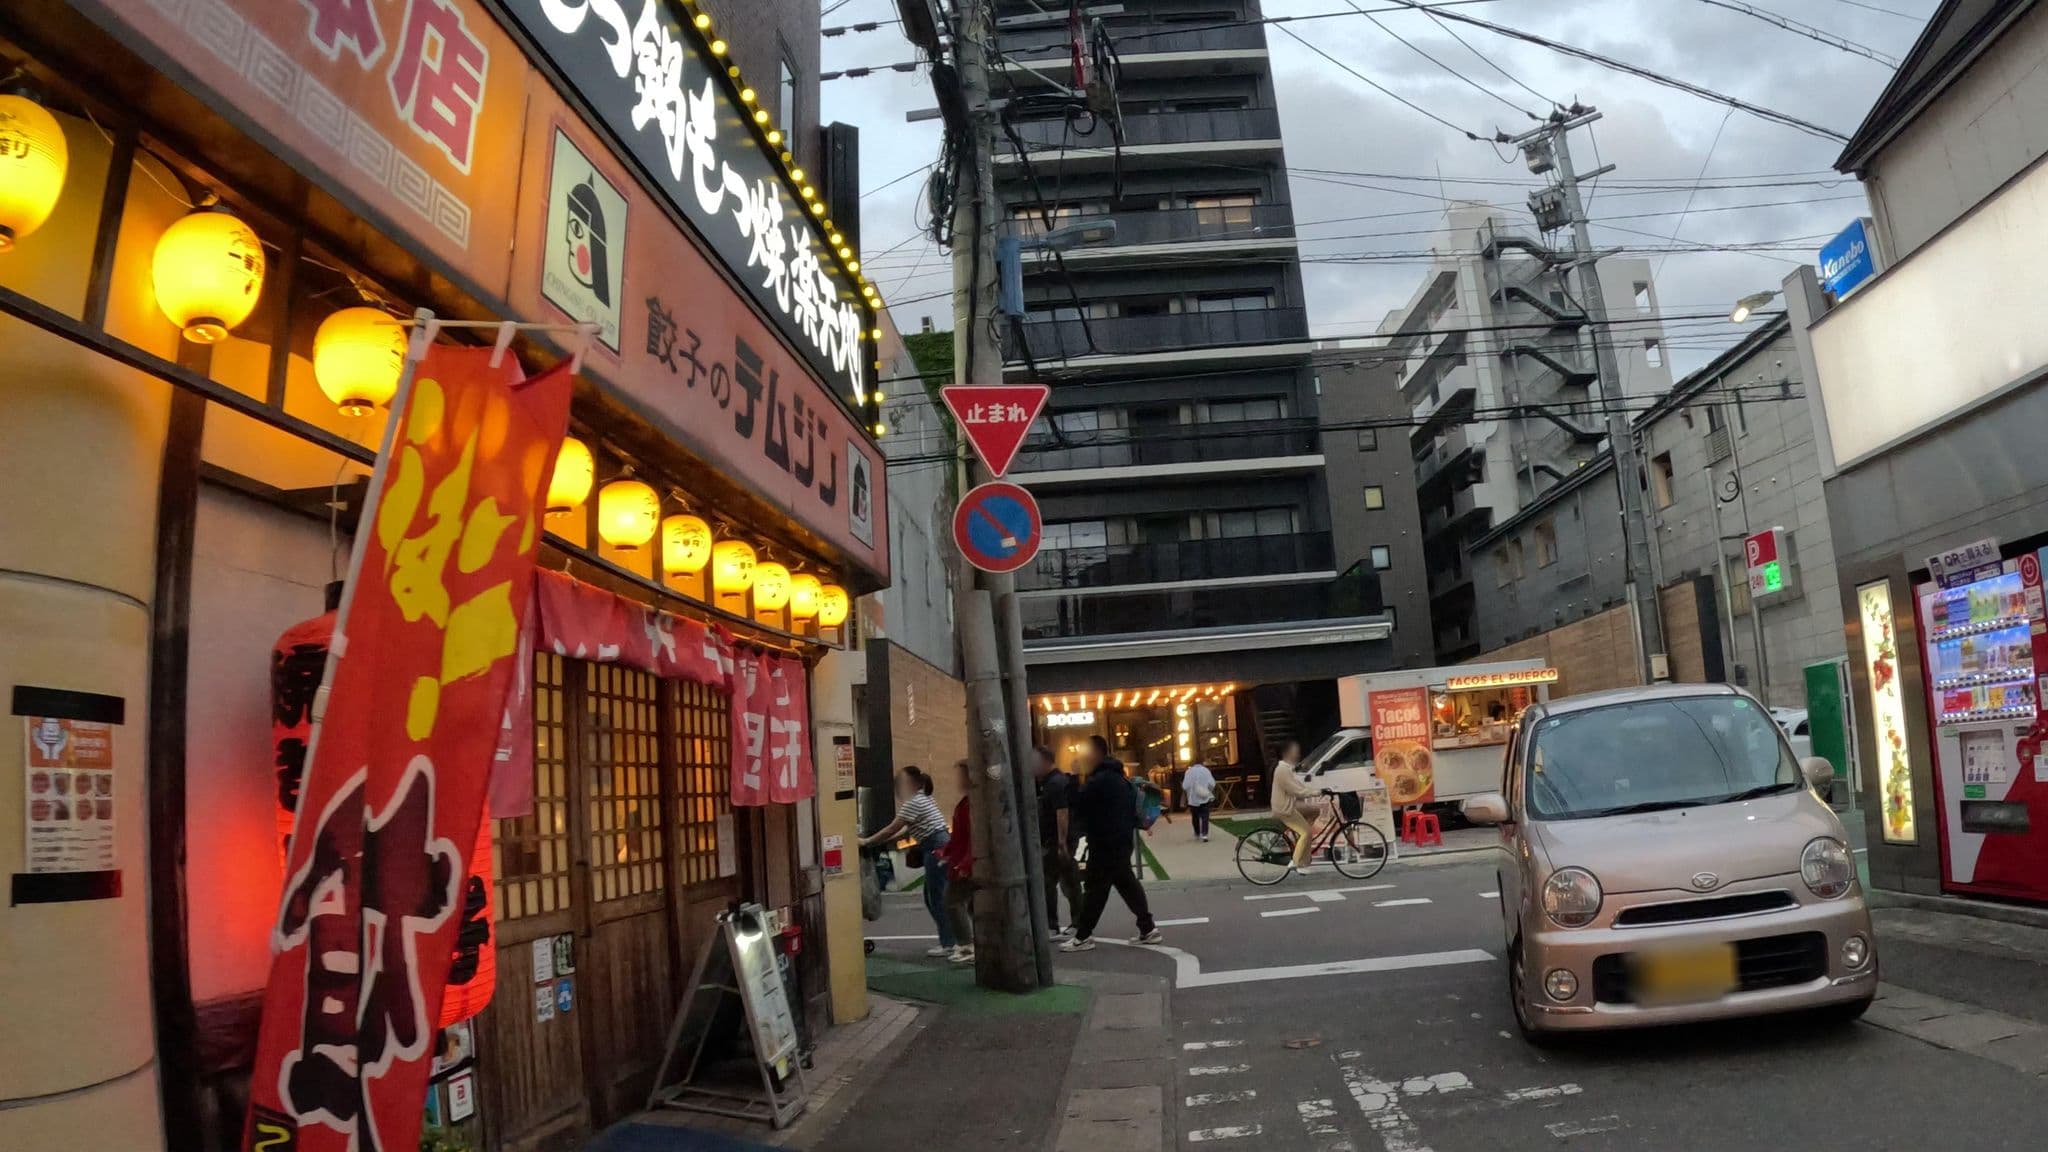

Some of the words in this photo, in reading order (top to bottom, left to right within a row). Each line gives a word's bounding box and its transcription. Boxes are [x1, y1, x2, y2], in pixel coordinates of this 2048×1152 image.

[1823, 239, 1865, 279] Kanebo
[646, 296, 837, 507] 餃子のテムジン
[965, 402, 1028, 424] 止まれ
[1746, 540, 1760, 568] P
[1448, 676, 1488, 687] TACOS
[1491, 674, 1505, 684] EL
[1508, 668, 1557, 682] PUERCO
[1376, 704, 1421, 724] Tacos
[1175, 703, 1192, 761] CAFE
